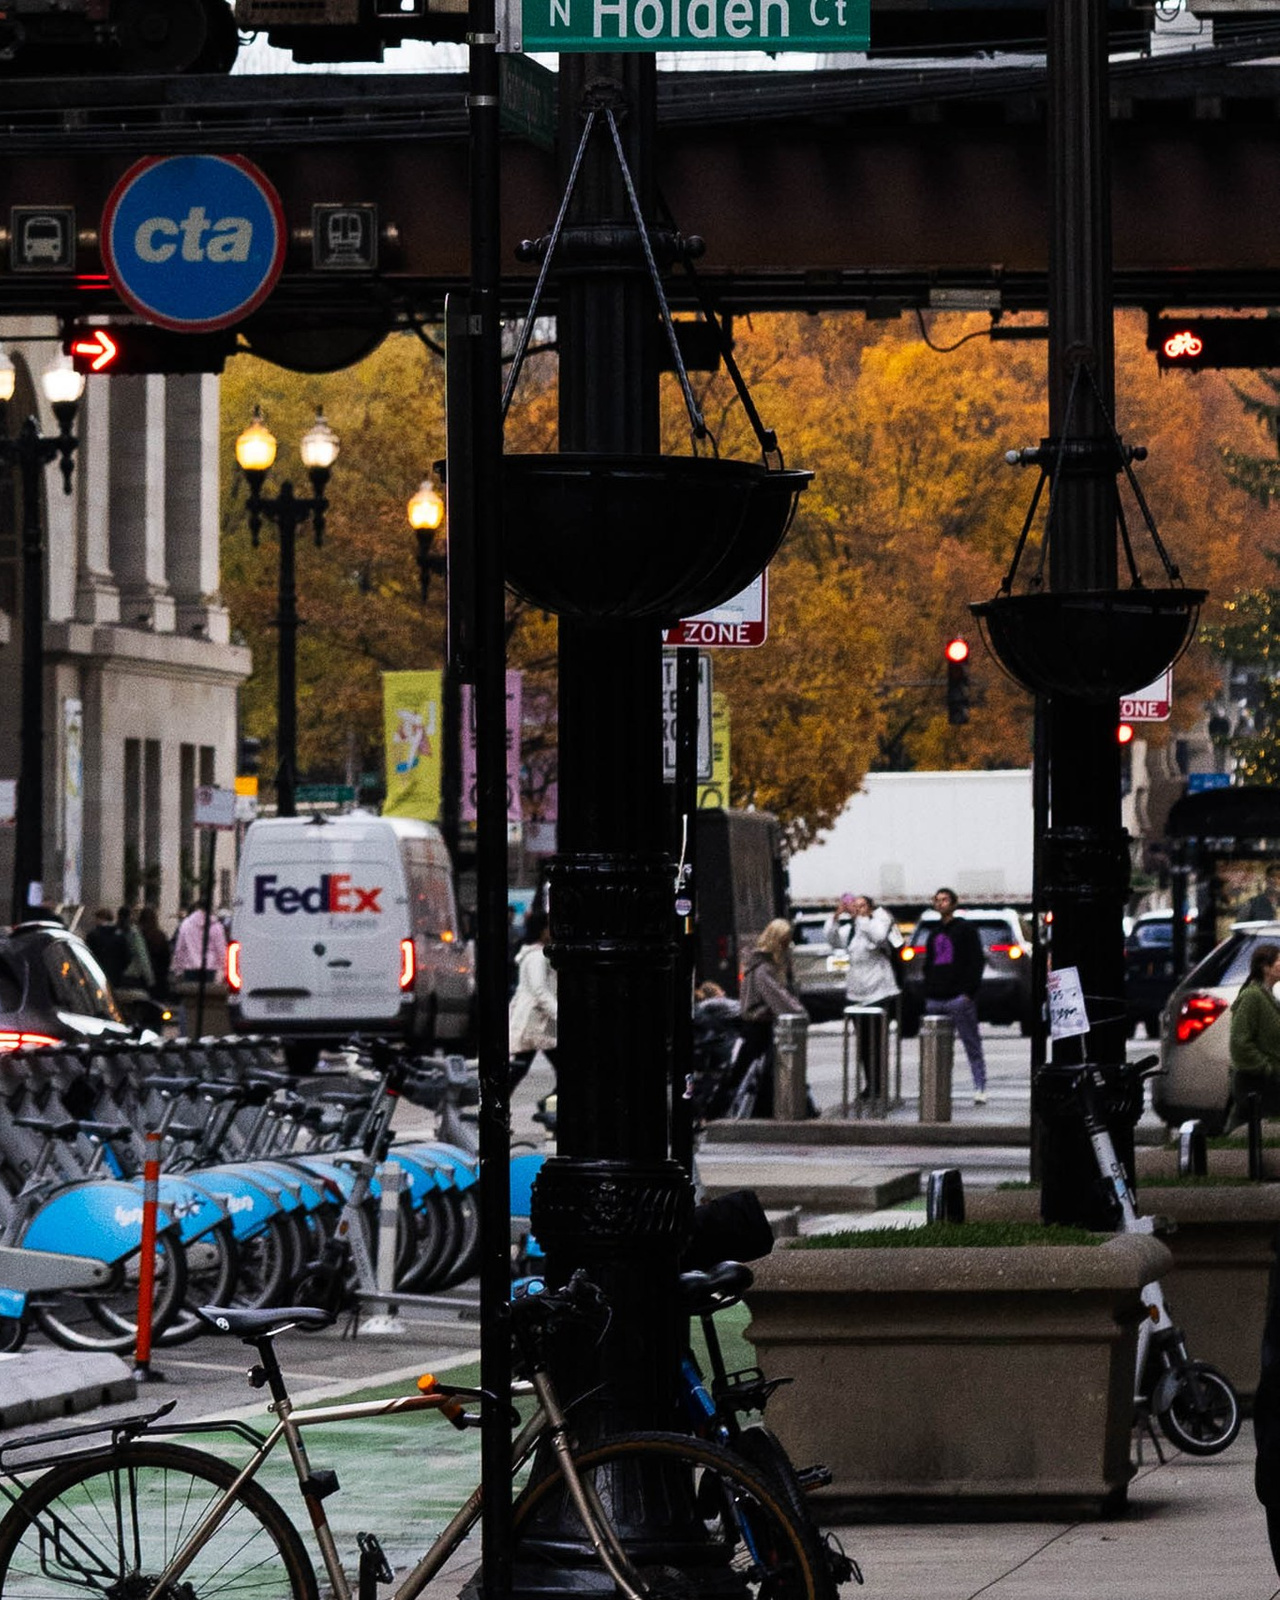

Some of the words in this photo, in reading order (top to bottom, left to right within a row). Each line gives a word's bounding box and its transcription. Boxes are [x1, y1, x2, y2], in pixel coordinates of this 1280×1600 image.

[134, 206, 253, 263] cta
[683, 622, 751, 643] ZONE
[1120, 701, 1159, 717] ONE
[254, 874, 383, 915] FedEx
